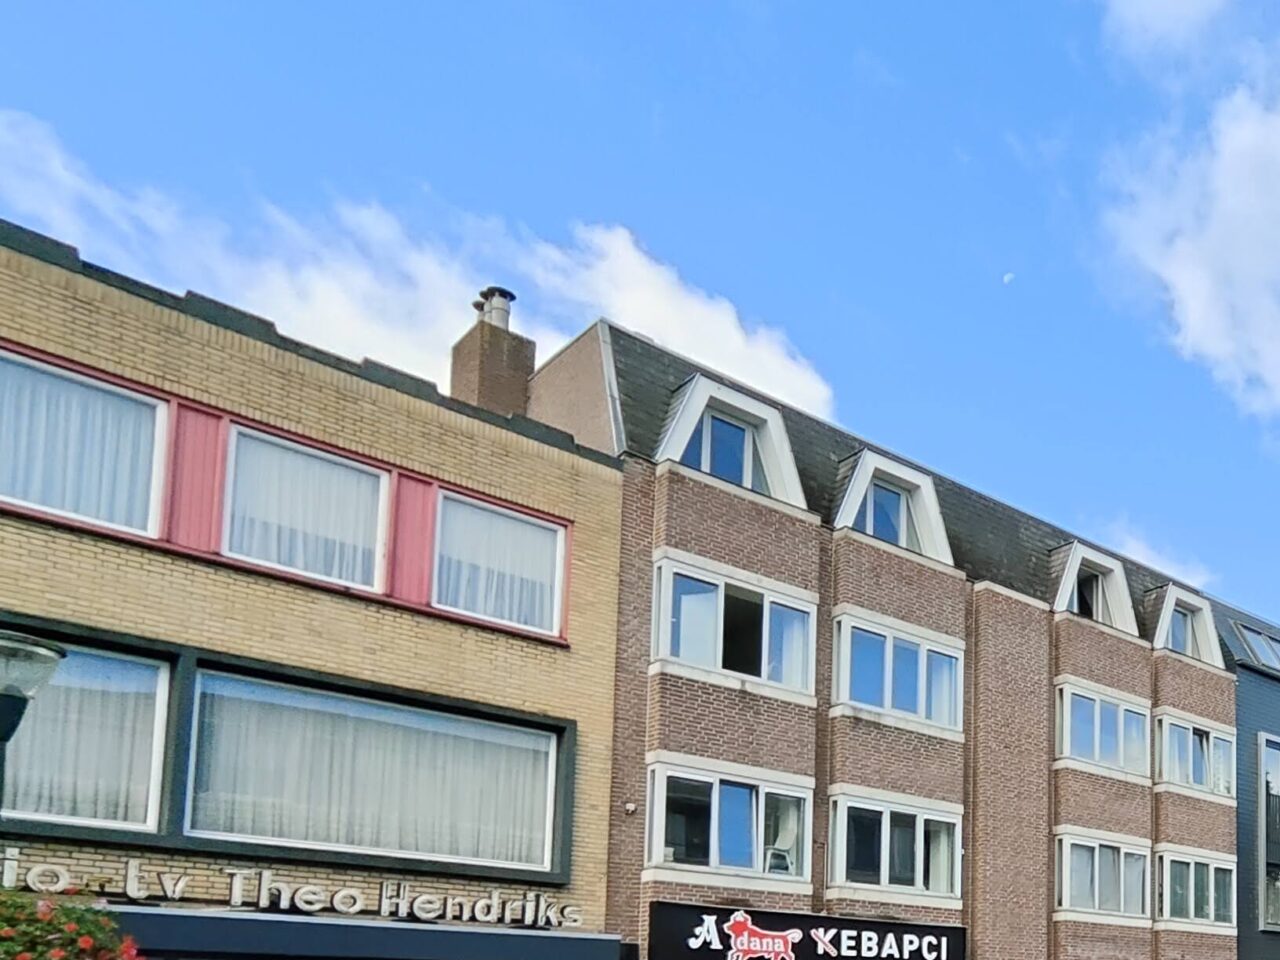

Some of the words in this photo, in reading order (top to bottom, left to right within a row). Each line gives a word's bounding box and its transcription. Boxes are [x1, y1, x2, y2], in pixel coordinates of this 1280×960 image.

[125, 858, 193, 901] tv
[222, 867, 365, 915] Theo
[380, 880, 584, 928] Hendriks
